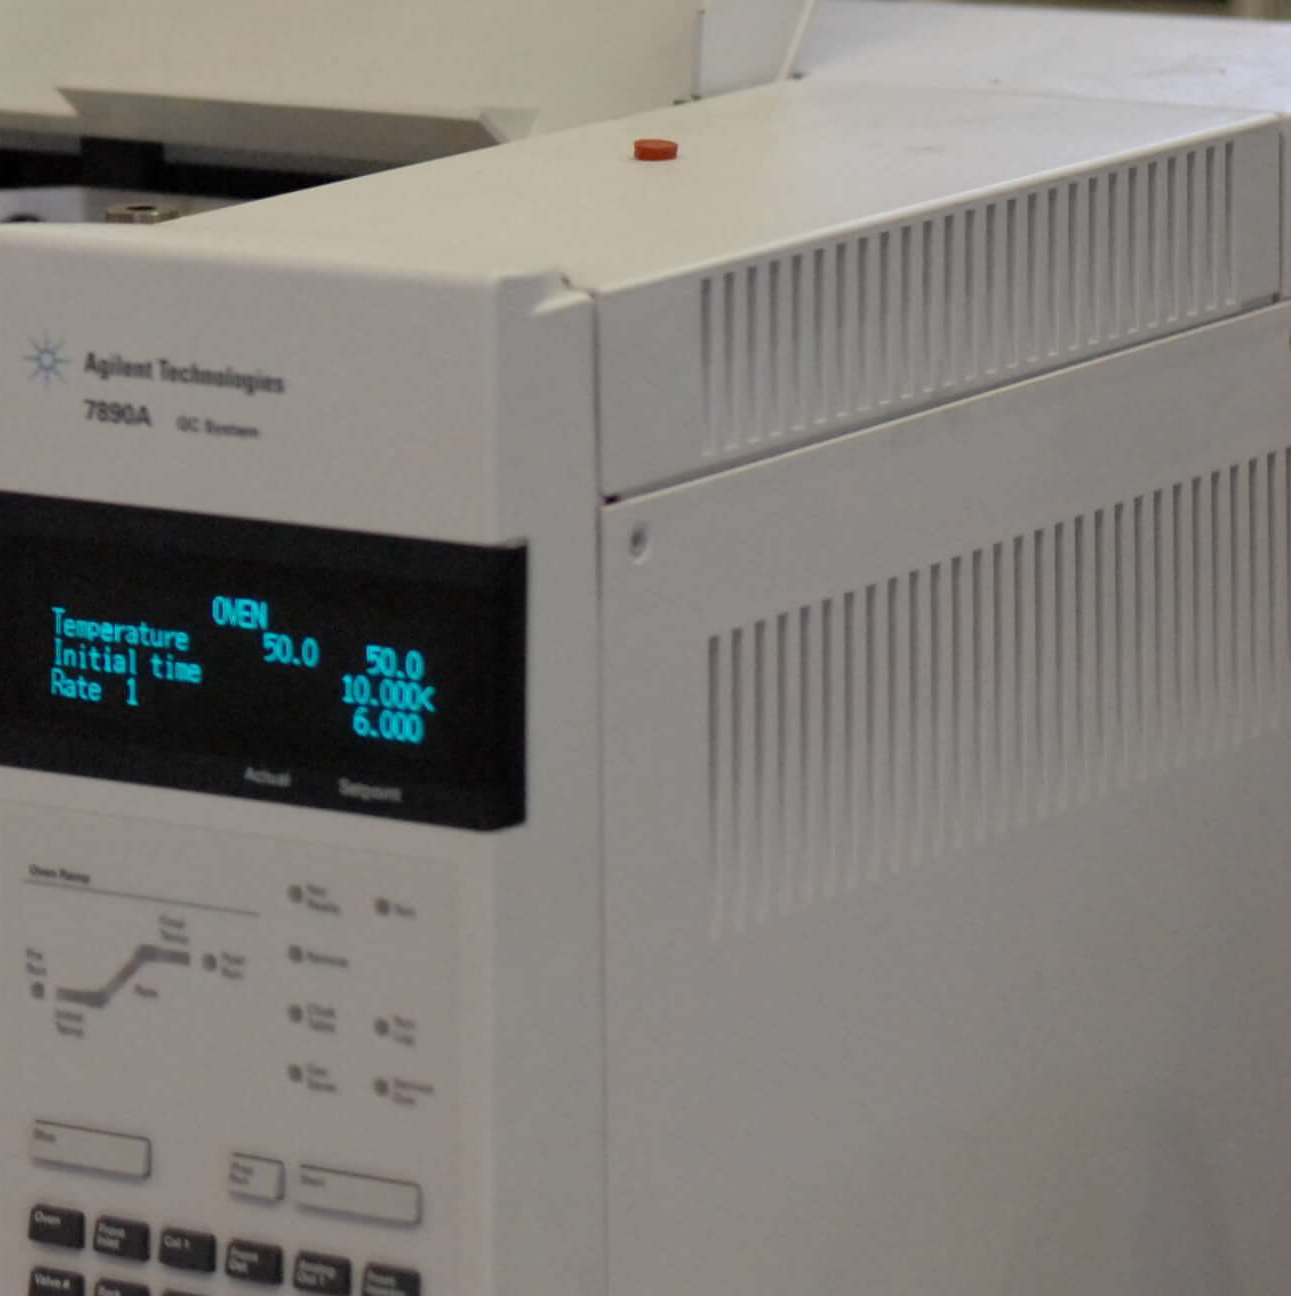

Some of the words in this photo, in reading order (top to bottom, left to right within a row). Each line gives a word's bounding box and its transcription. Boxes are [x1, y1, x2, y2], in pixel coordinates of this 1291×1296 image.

[83, 350, 153, 380] Agilent
[157, 357, 286, 395] Technologies
[83, 398, 152, 427] 7890A
[212, 595, 269, 631] OVEN
[51, 607, 190, 652] Temperature
[262, 632, 320, 669] 50.0
[365, 644, 425, 681] 50.0
[53, 638, 137, 675] Initial
[151, 653, 203, 684] time
[50, 667, 103, 703] Rate
[125, 678, 140, 708] 1
[352, 706, 424, 744] 6.000
